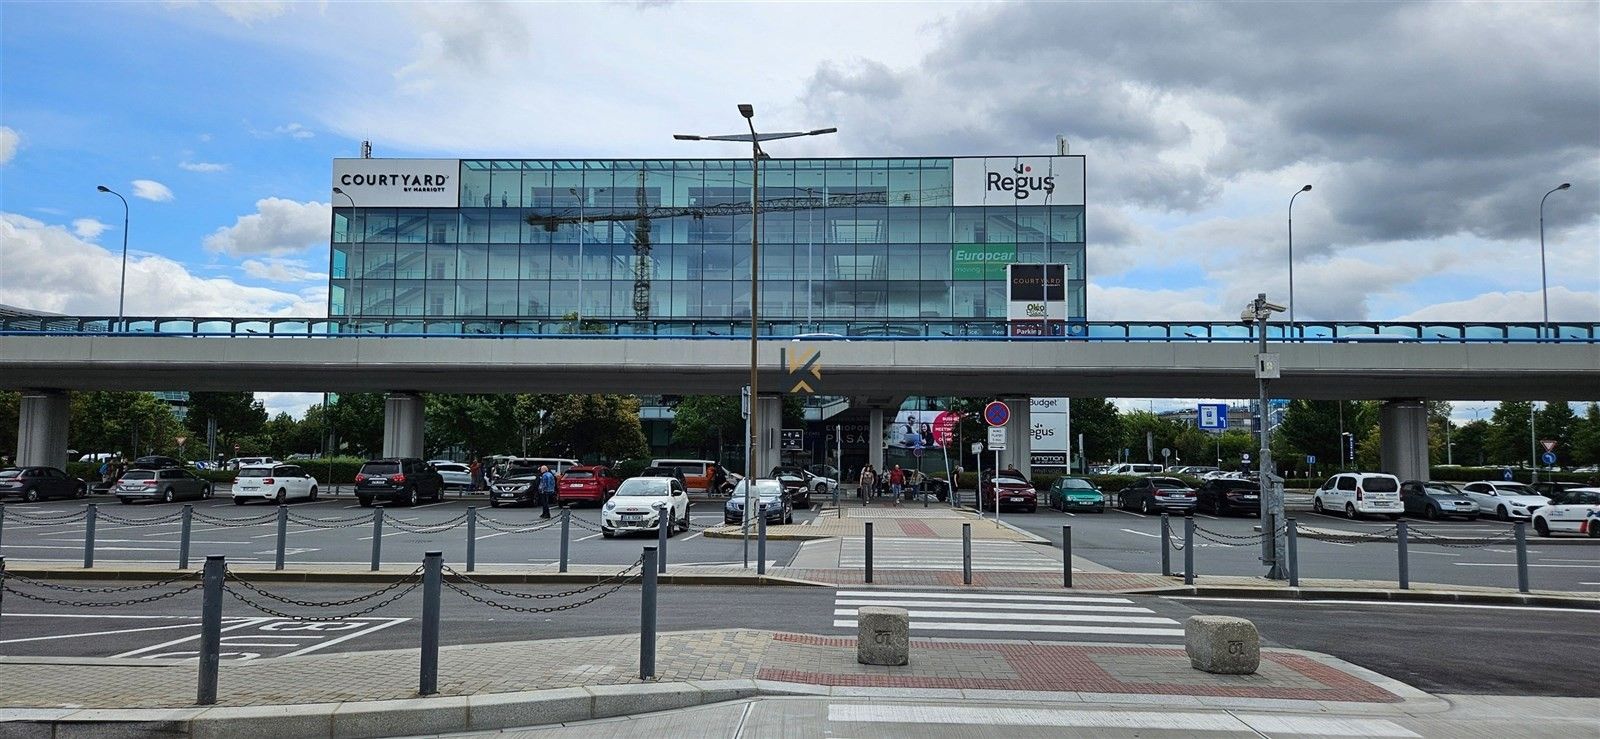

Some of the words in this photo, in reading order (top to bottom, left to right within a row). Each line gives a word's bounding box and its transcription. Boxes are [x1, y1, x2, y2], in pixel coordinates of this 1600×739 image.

[341, 174, 446, 186] COURTYARD
[987, 172, 1055, 200] Regus
[956, 250, 1014, 264] Europcar
[1030, 428, 1054, 440] egus
